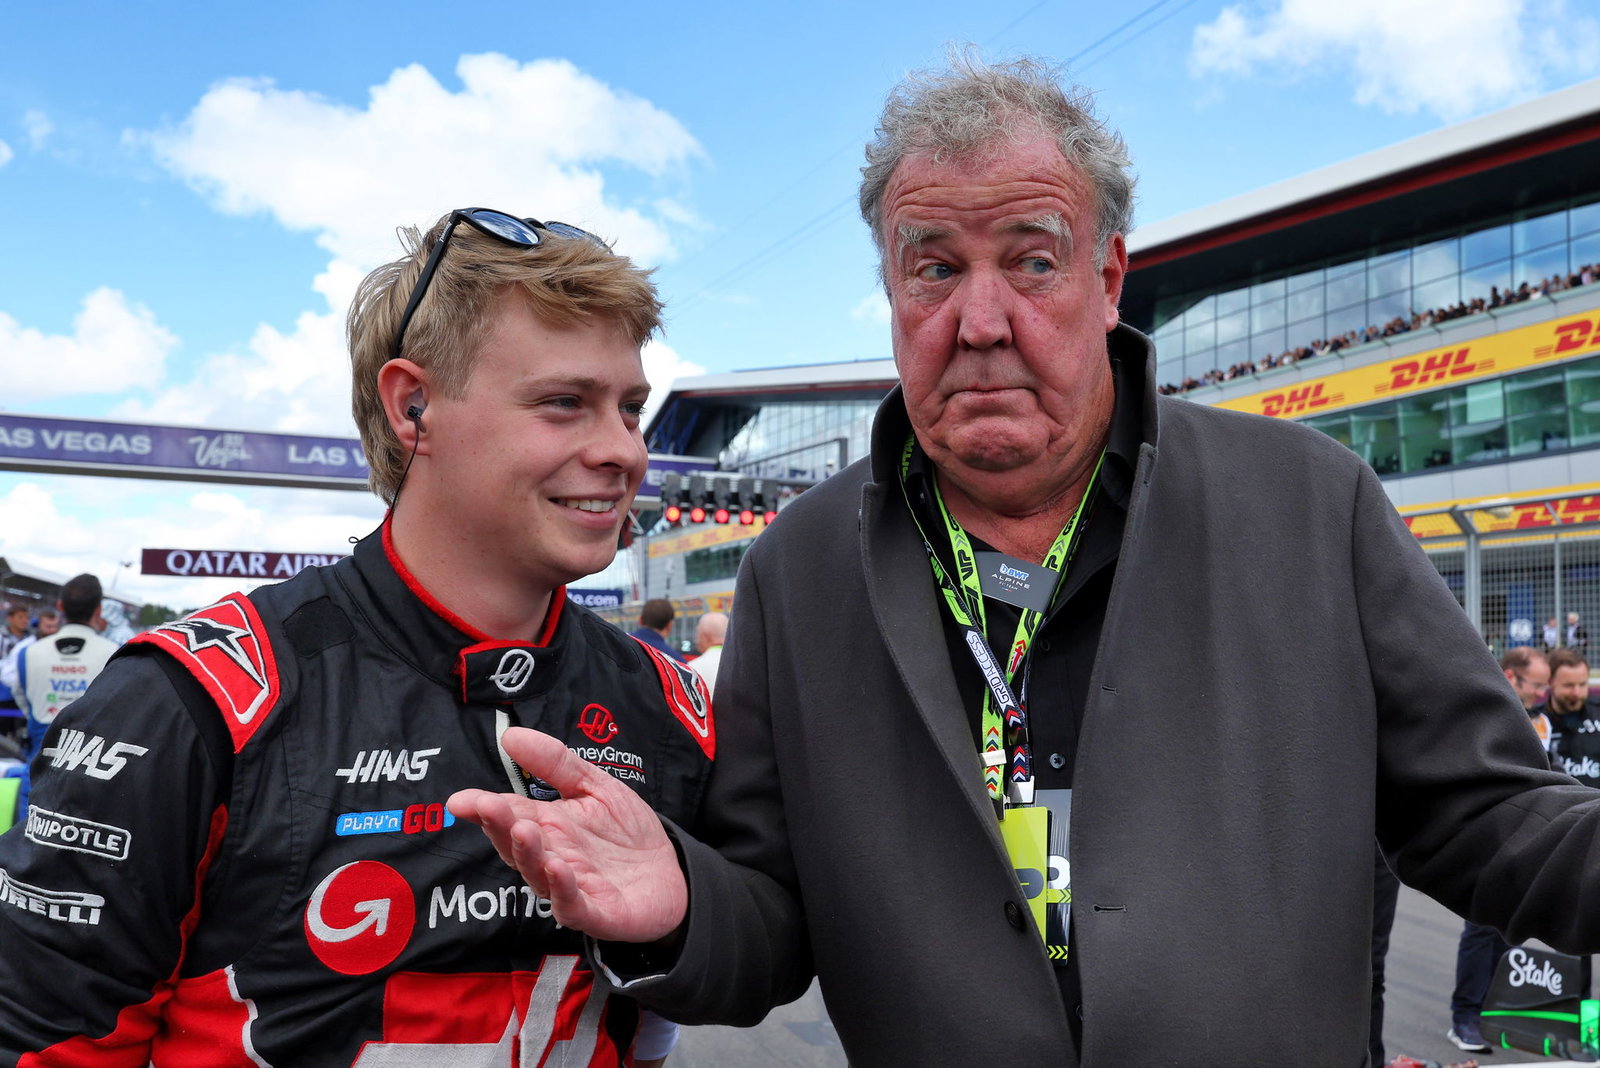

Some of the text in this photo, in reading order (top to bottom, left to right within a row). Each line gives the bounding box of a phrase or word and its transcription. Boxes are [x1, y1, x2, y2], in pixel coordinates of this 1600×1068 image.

[1390, 347, 1476, 390] DHL
[1261, 383, 1329, 417] DHL
[0, 426, 152, 455] AS VEGAS
[288, 445, 348, 466] LAS
[166, 550, 267, 575] QATAR
[1008, 567, 1029, 581] BWT
[991, 573, 1031, 590] ALPINE
[52, 665, 87, 674] HUGO
[967, 634, 997, 678] ACCESS
[50, 679, 88, 692] VISA
[990, 676, 1010, 705] GRID
[43, 728, 149, 781] HAAS
[335, 747, 441, 784] HAAS
[1563, 756, 1600, 778] take
[612, 767, 646, 784] TEAM
[403, 803, 444, 834] GO
[34, 815, 122, 852] HIPOTLE
[1508, 949, 1562, 995] Stake
